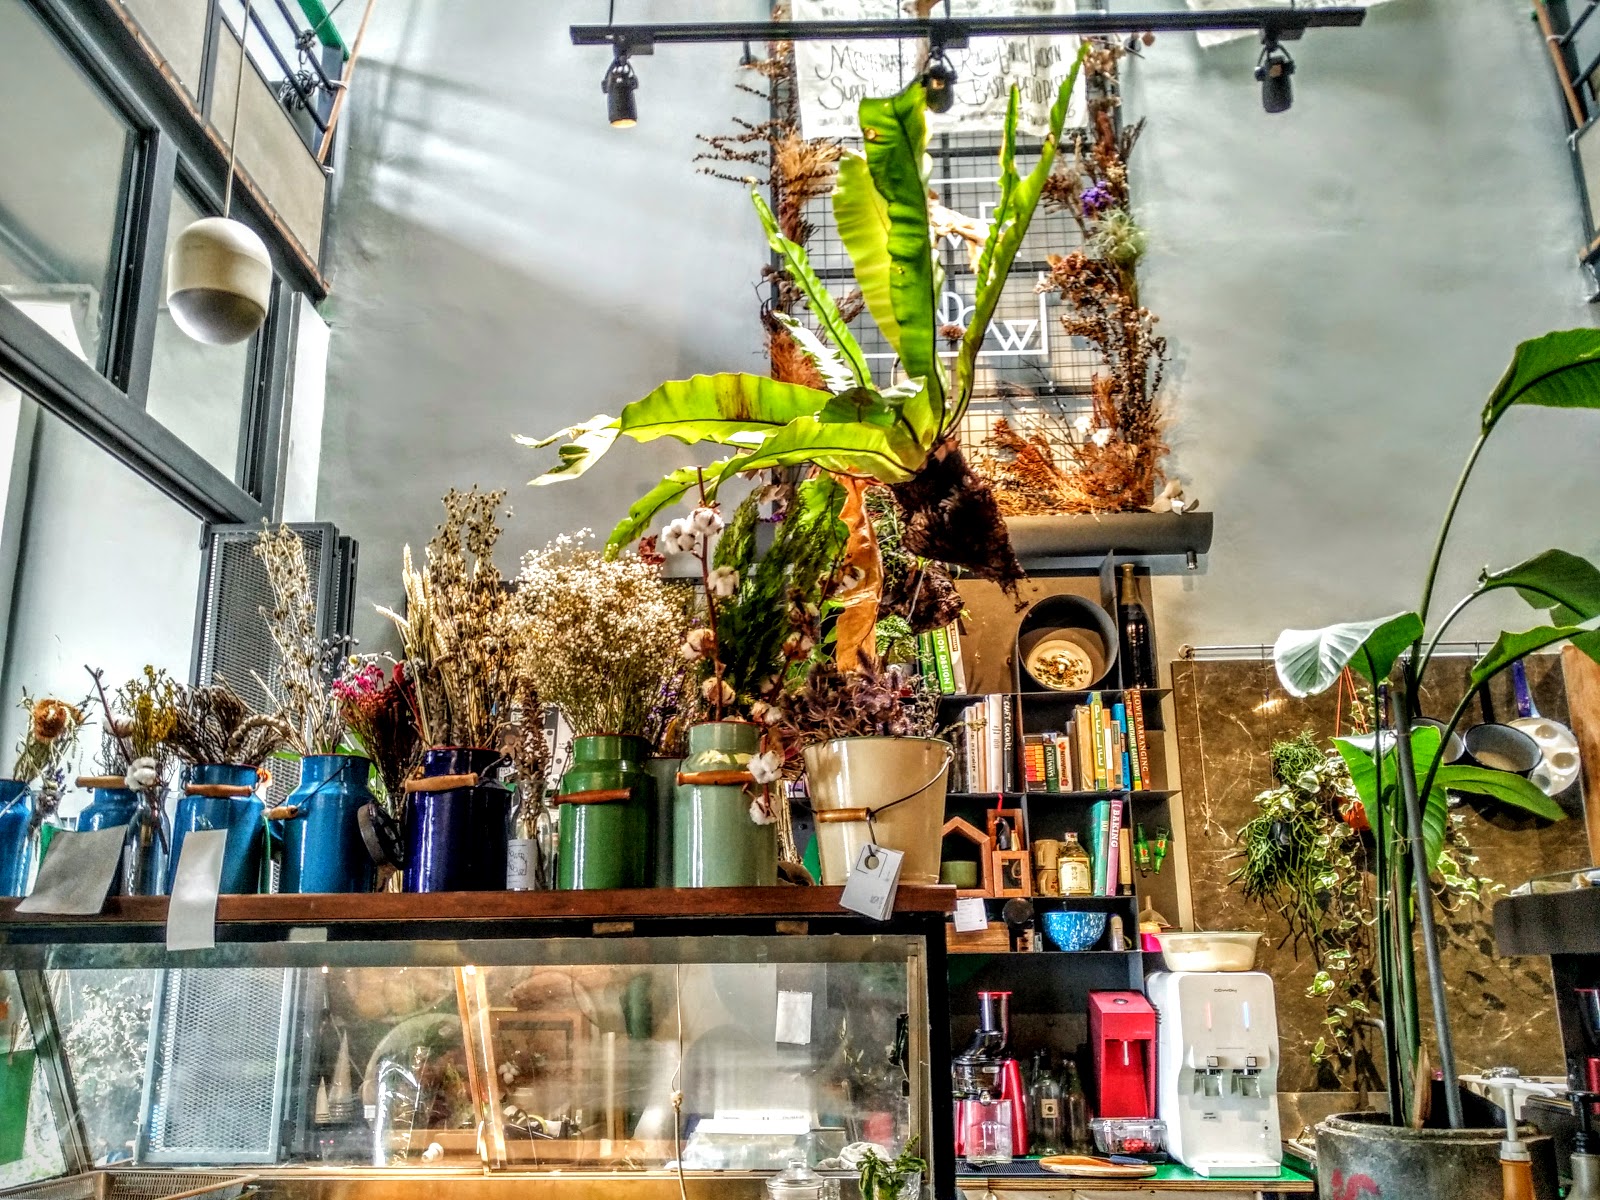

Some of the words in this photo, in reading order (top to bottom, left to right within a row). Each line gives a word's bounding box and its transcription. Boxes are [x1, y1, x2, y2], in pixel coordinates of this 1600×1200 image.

[940, 654, 951, 685] DESIGN
[1133, 690, 1143, 722] FLOWER
[1137, 725, 1149, 772] ARRANGING
[1110, 809, 1120, 848] BAKING
